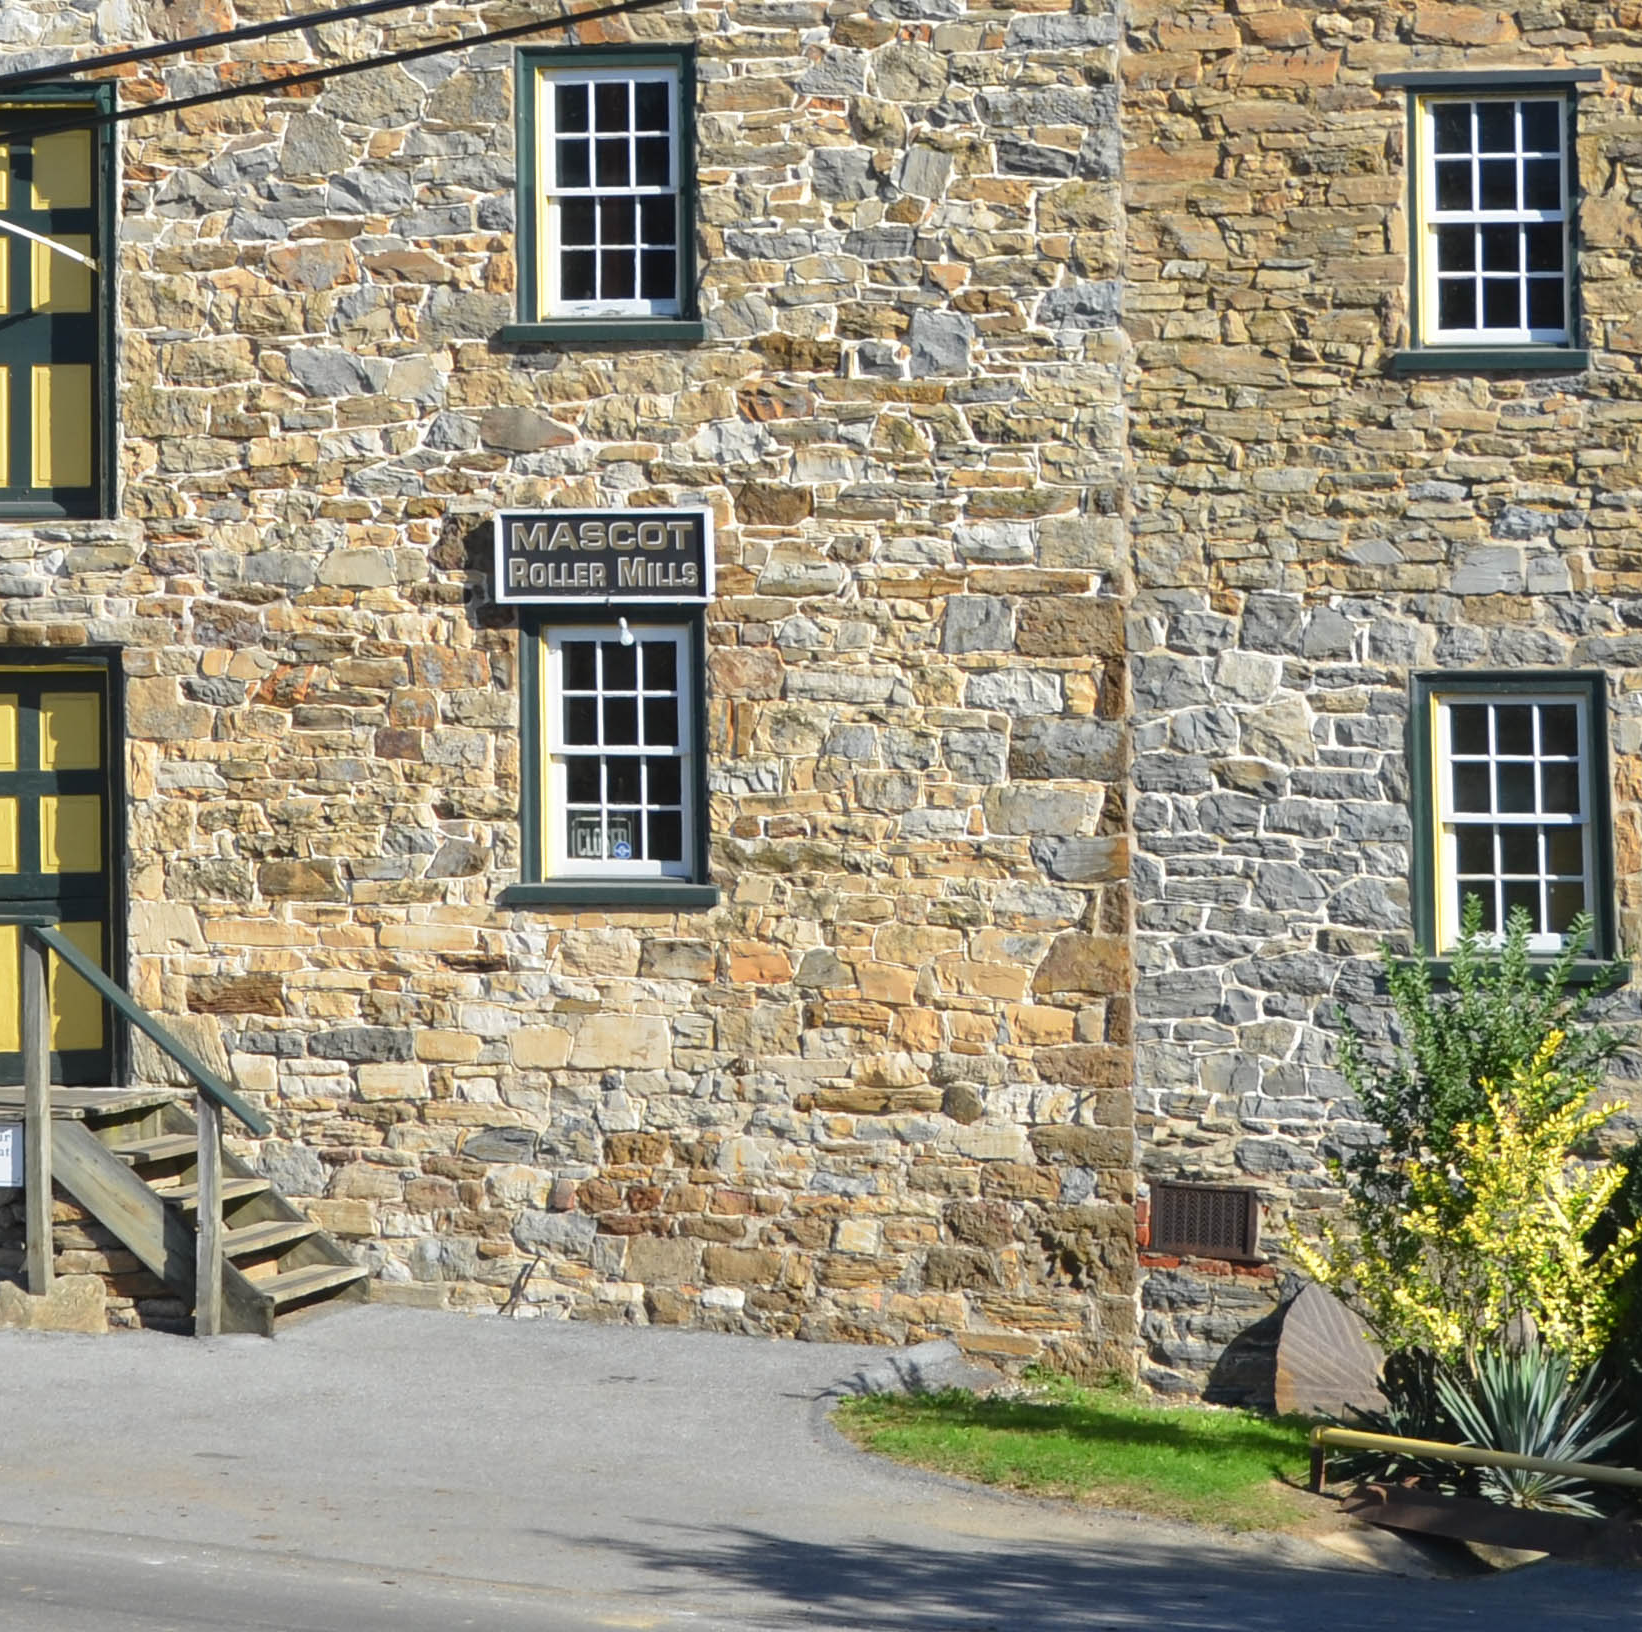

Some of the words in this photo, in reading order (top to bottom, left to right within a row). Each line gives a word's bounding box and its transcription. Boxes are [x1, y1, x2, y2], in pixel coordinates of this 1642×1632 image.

[511, 522, 694, 551] MASCOT
[509, 558, 607, 588] ROLLER
[617, 557, 699, 588] MILLS
